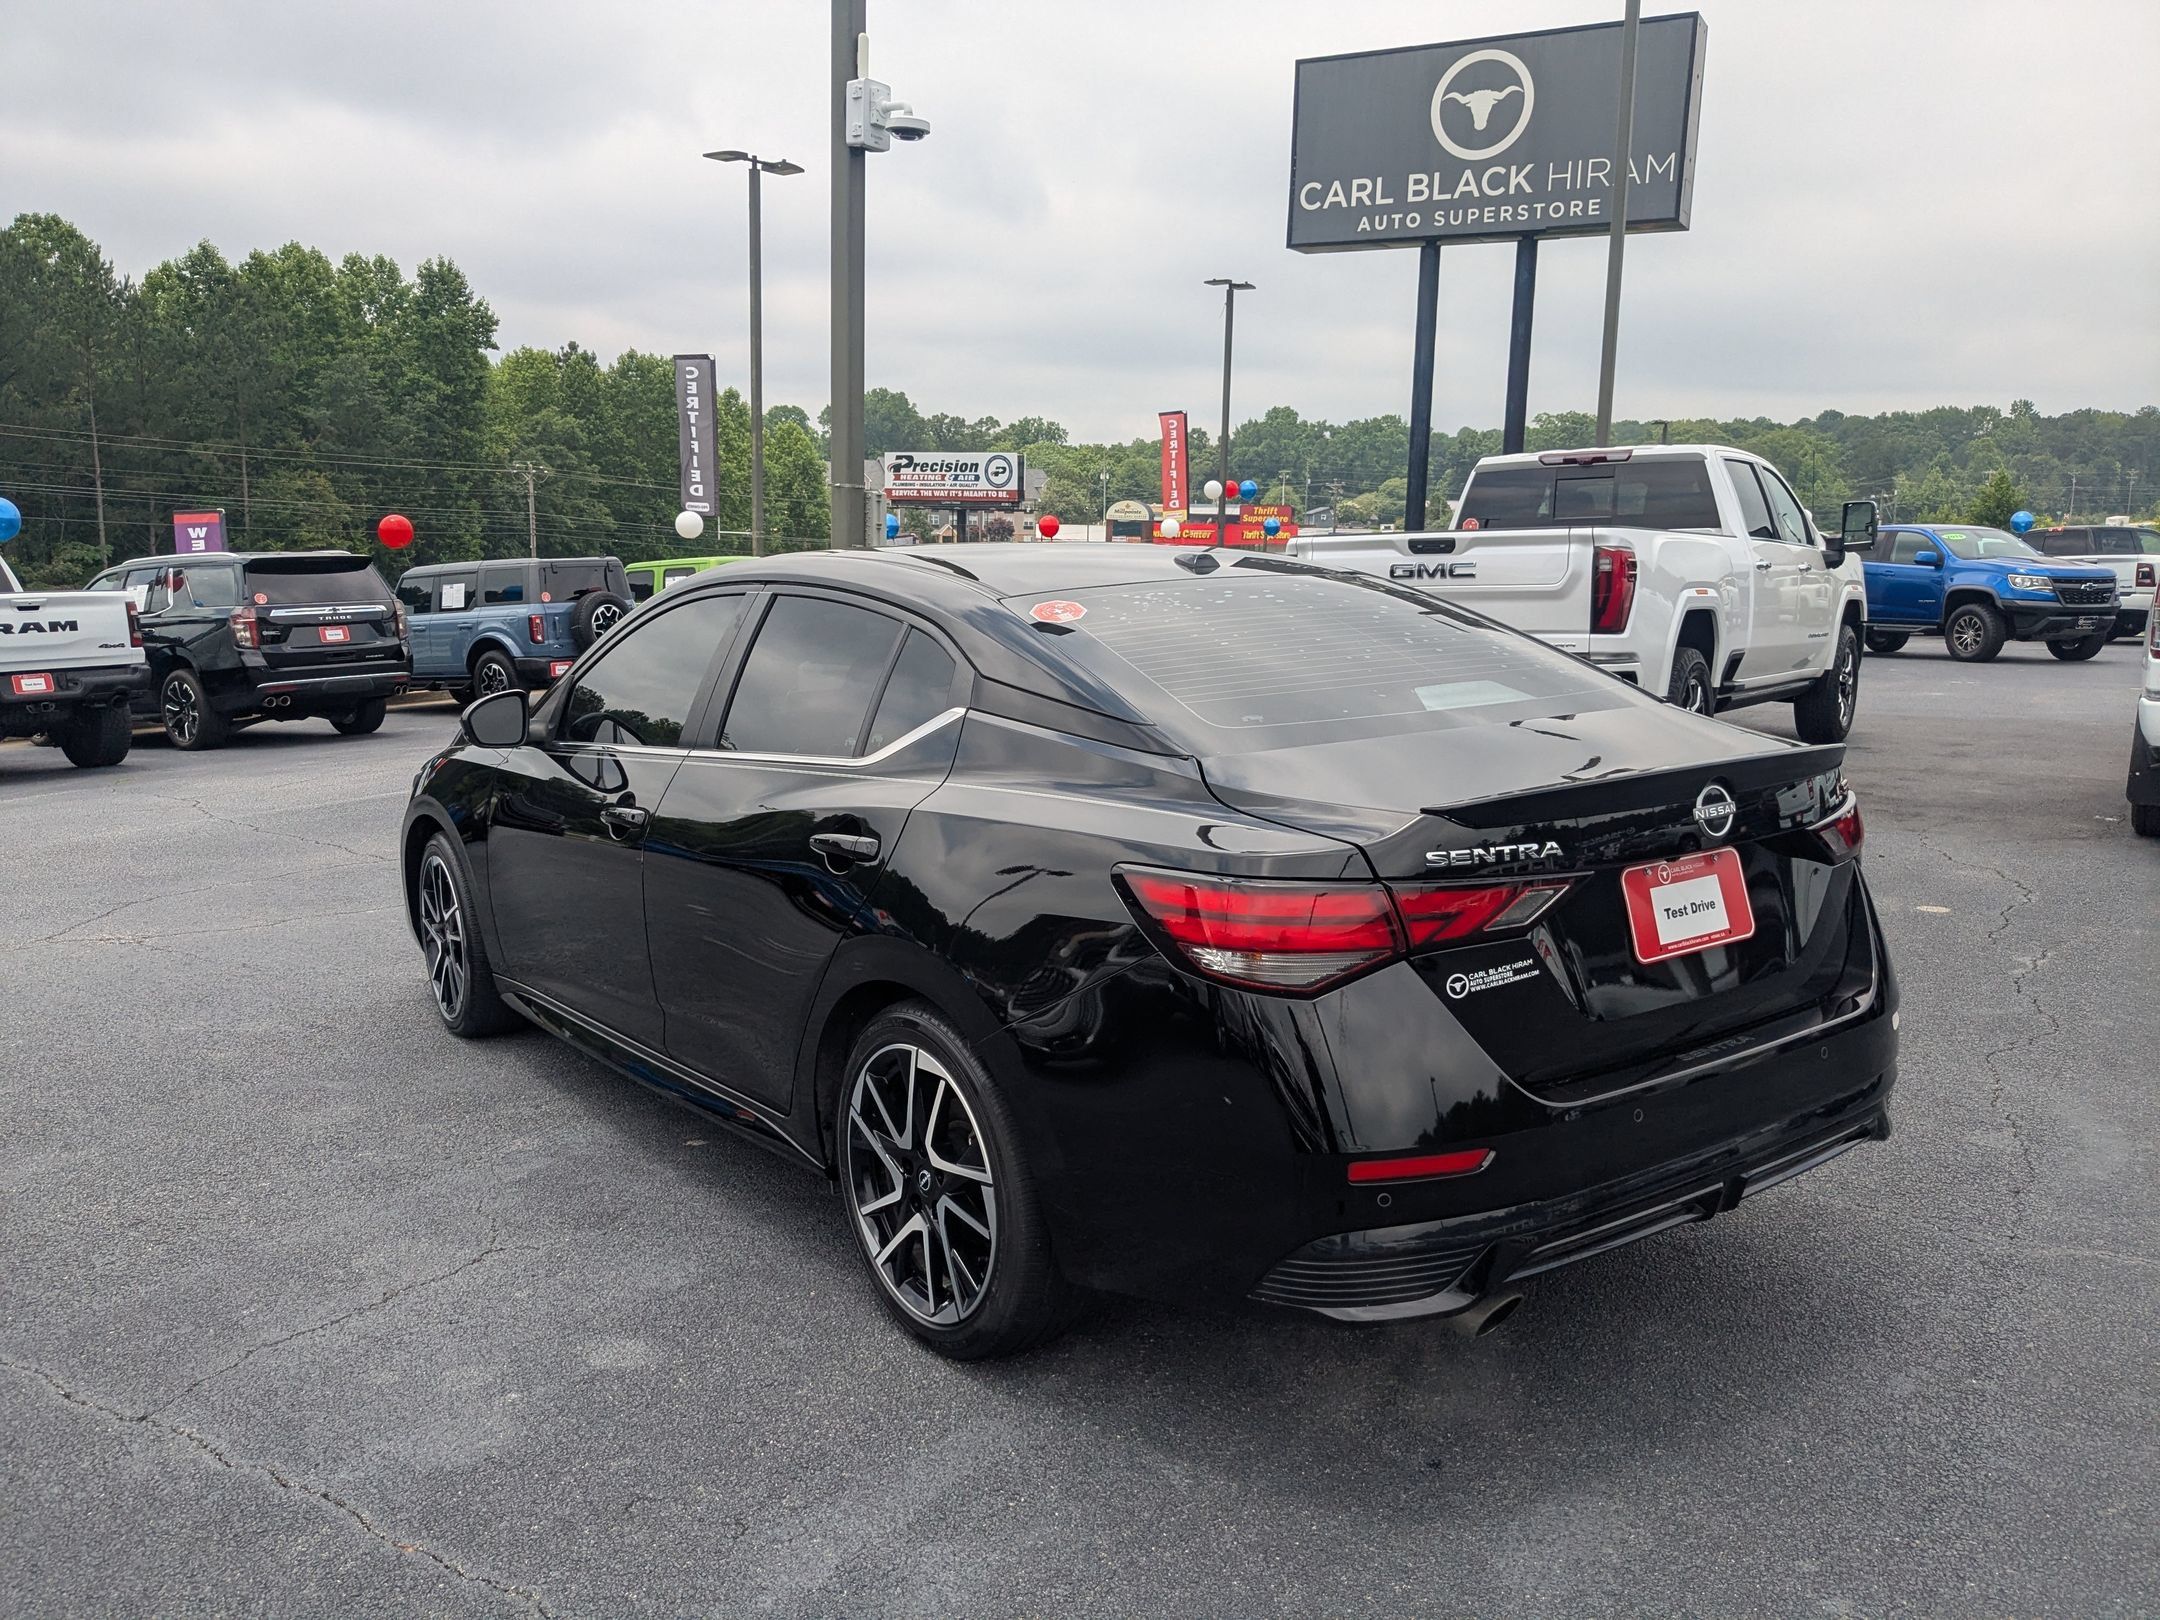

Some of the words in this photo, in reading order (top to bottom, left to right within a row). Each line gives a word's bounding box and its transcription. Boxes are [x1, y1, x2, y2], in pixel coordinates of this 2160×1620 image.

[1299, 177, 1394, 211] CARL
[1407, 163, 1533, 203] BLACK
[1357, 213, 1421, 232] AUTO
[1433, 199, 1601, 227] SUPERSTORE
[887, 455, 979, 473] Precision
[963, 490, 987, 498] MEANT
[1254, 507, 1278, 515] Thrift
[1182, 529, 1212, 539] Center
[1389, 562, 1477, 579] GMC
[1694, 803, 1736, 819] NISSAN
[1425, 841, 1564, 867] SENTRA
[1664, 905, 1688, 919] Test
[1691, 900, 1716, 914] Drive
[1468, 970, 1488, 980] CARL
[1489, 964, 1511, 975] BLACK
[1511, 958, 1533, 970] HIRAM
[1470, 978, 1483, 986] AUTO
[1484, 970, 1513, 983] SUPERSTORE
